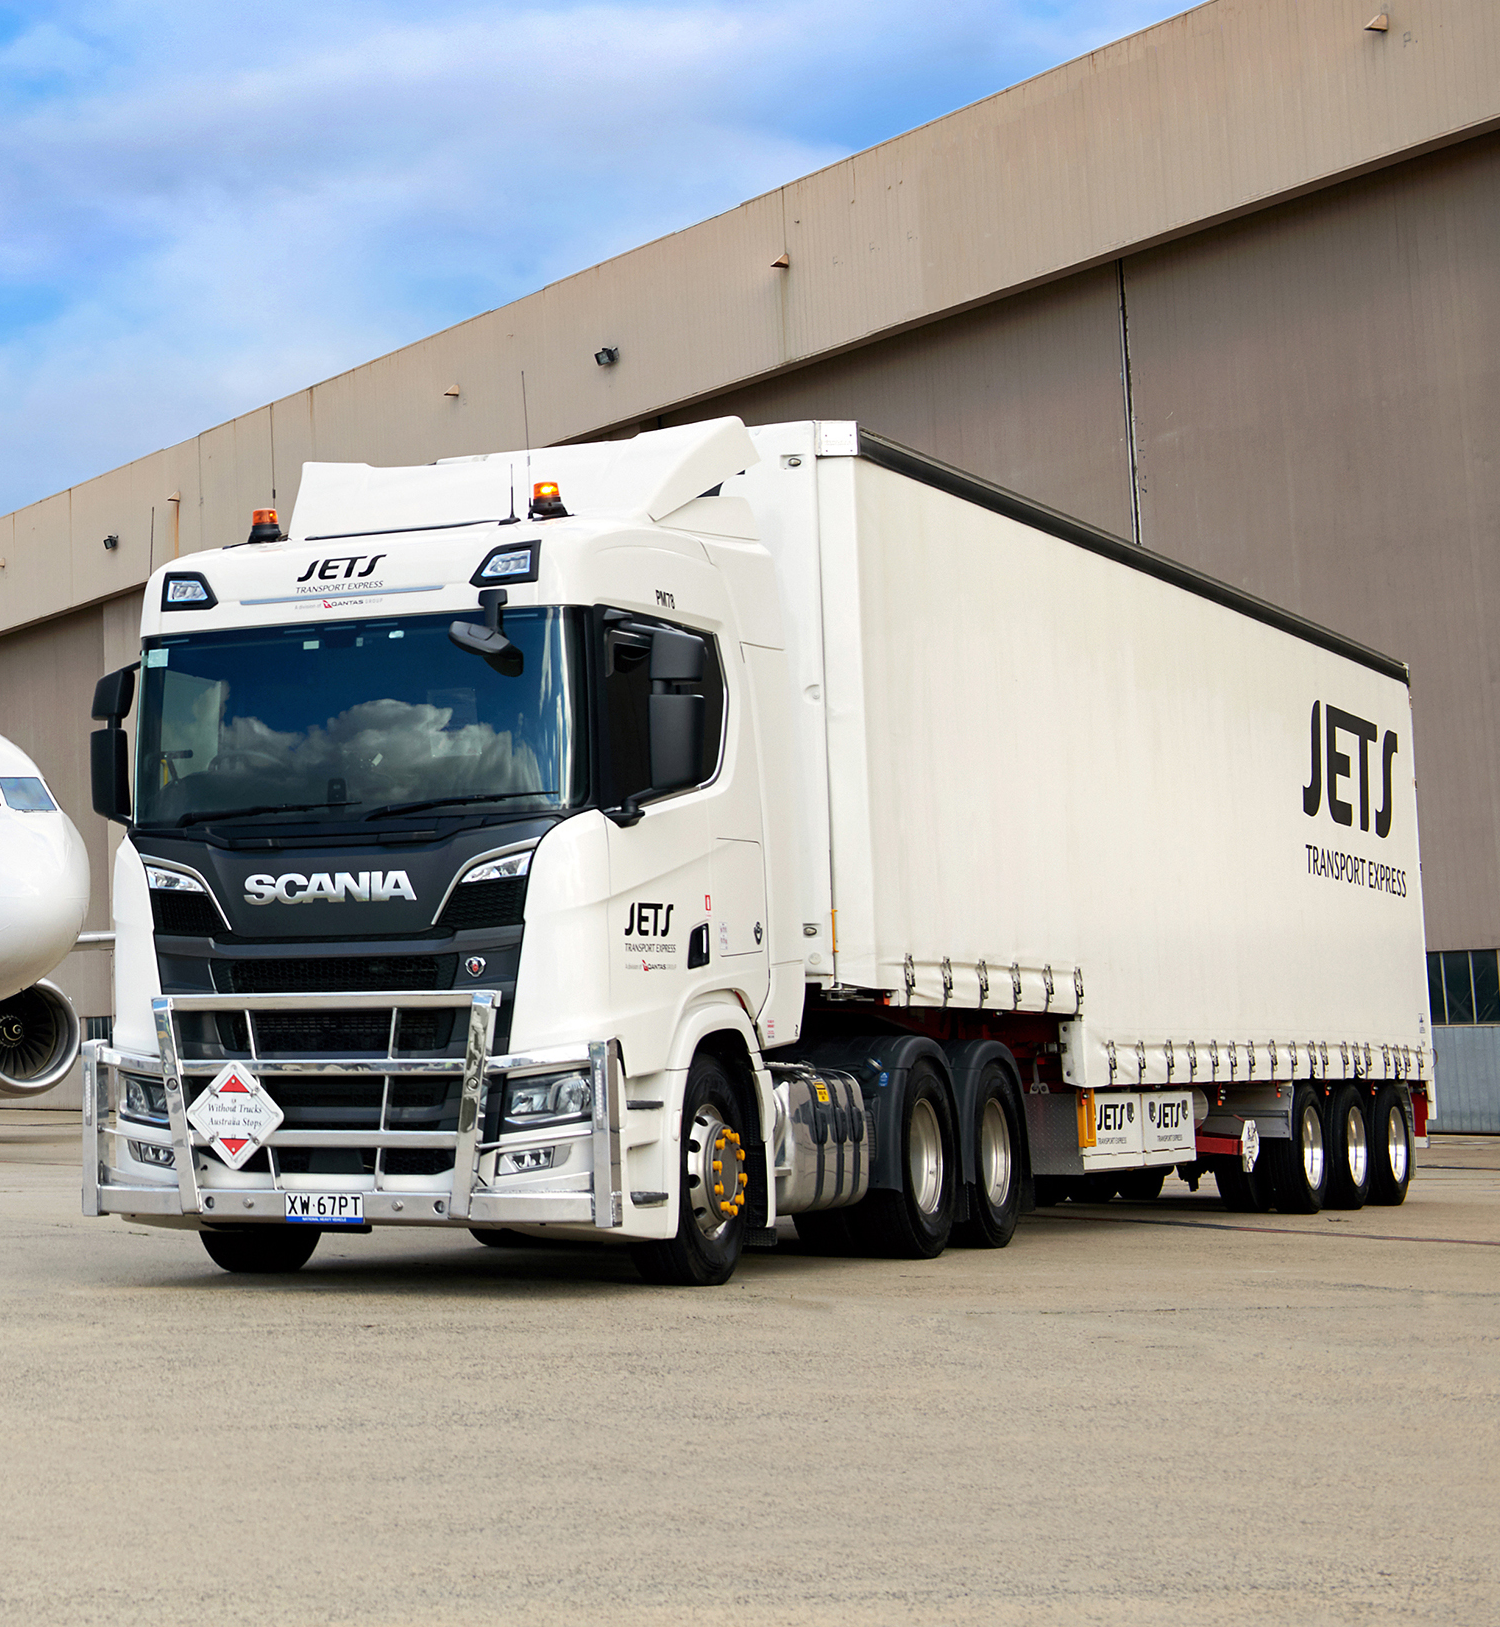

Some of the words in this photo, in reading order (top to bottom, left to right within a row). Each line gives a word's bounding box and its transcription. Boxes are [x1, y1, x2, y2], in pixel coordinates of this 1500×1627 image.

[297, 553, 387, 582] JETS
[296, 583, 345, 594] TRANSPORT
[348, 580, 383, 590] EXPRESS
[655, 589, 675, 610] PM78
[1303, 700, 1398, 839] JETS
[1305, 844, 1366, 887] TRANSPORT
[1368, 861, 1407, 898] EXPRESS
[243, 870, 417, 906] SCANIA
[624, 902, 674, 937] JETS
[625, 943, 655, 953] TRANSPORT
[656, 943, 676, 953] EXPRESS
[208, 1103, 236, 1113] Without
[239, 1104, 262, 1113] Trucks
[1097, 1104, 1125, 1130] JETS
[1156, 1103, 1181, 1129] JETS
[209, 1117, 240, 1126] Australia
